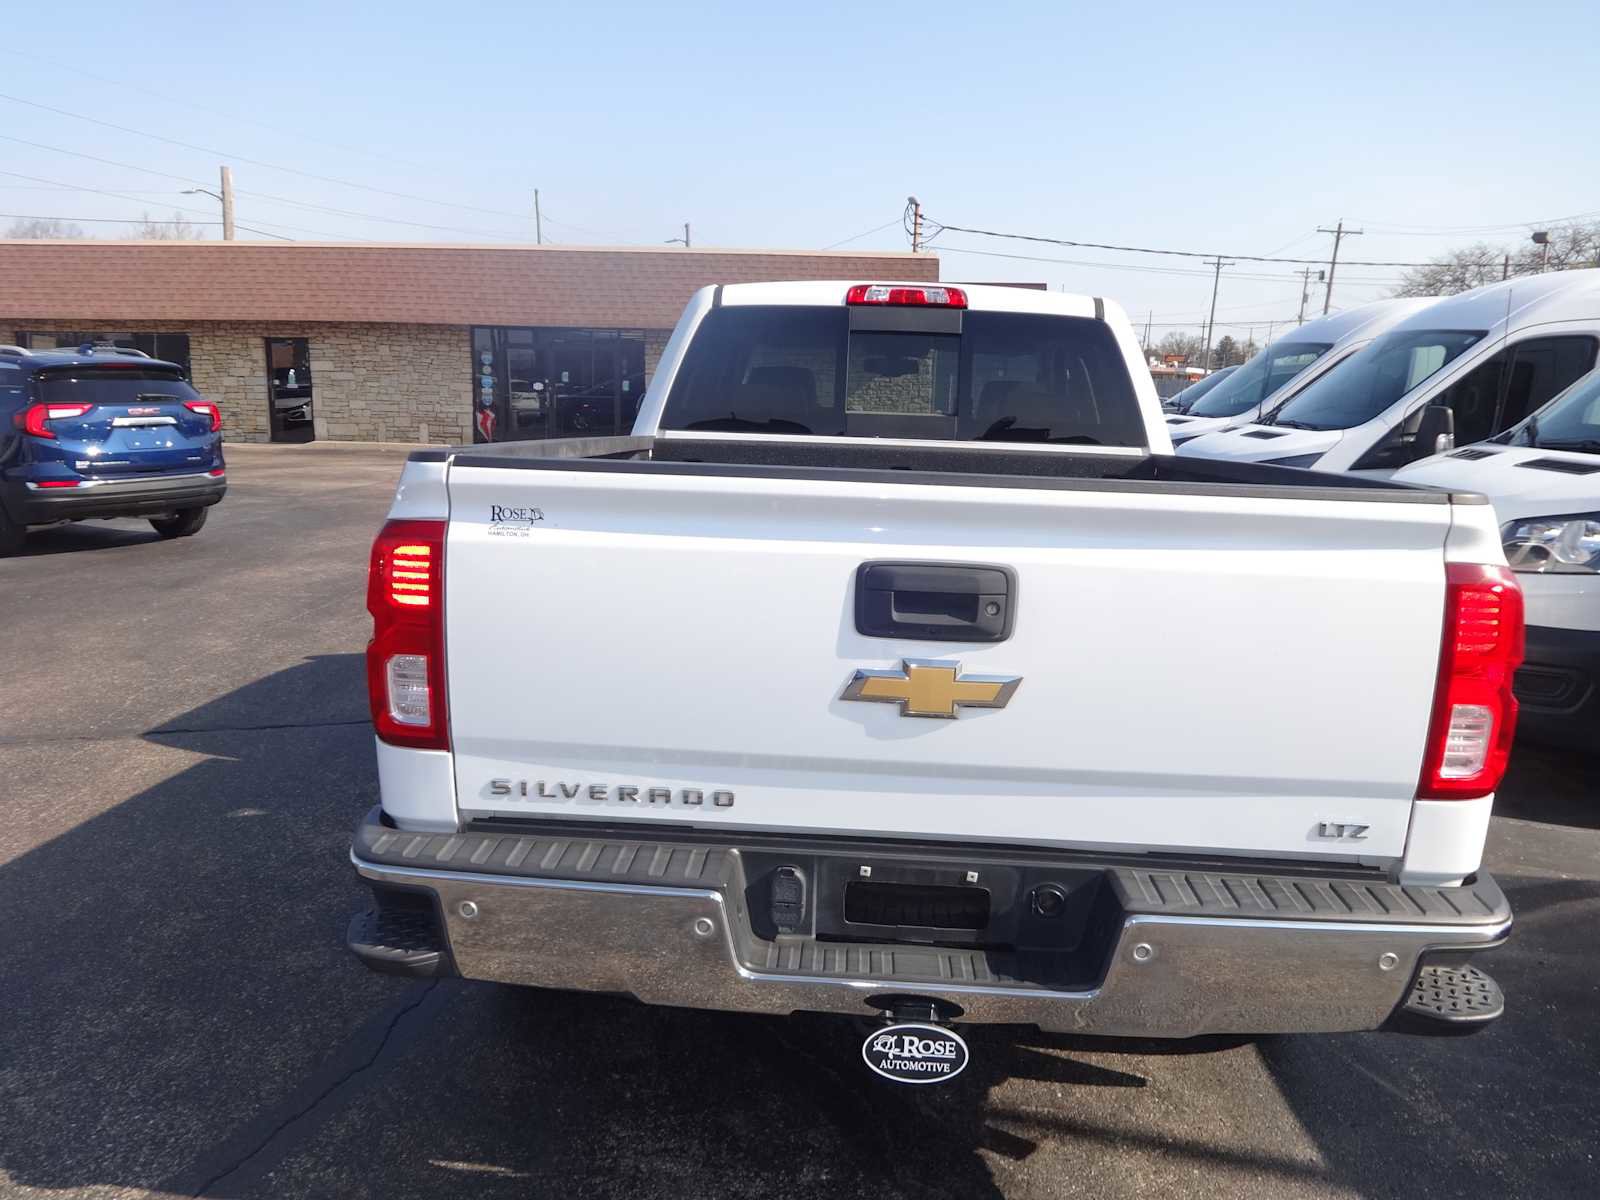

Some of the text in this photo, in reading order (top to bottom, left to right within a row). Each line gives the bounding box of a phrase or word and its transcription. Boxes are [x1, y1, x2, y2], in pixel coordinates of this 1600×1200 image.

[490, 505, 528, 522] ROSE
[490, 778, 735, 807] SILVERADO
[1319, 822, 1370, 838] LTZ
[902, 1035, 956, 1058] ROSE
[879, 1059, 951, 1073] AUTOMOTIVE
